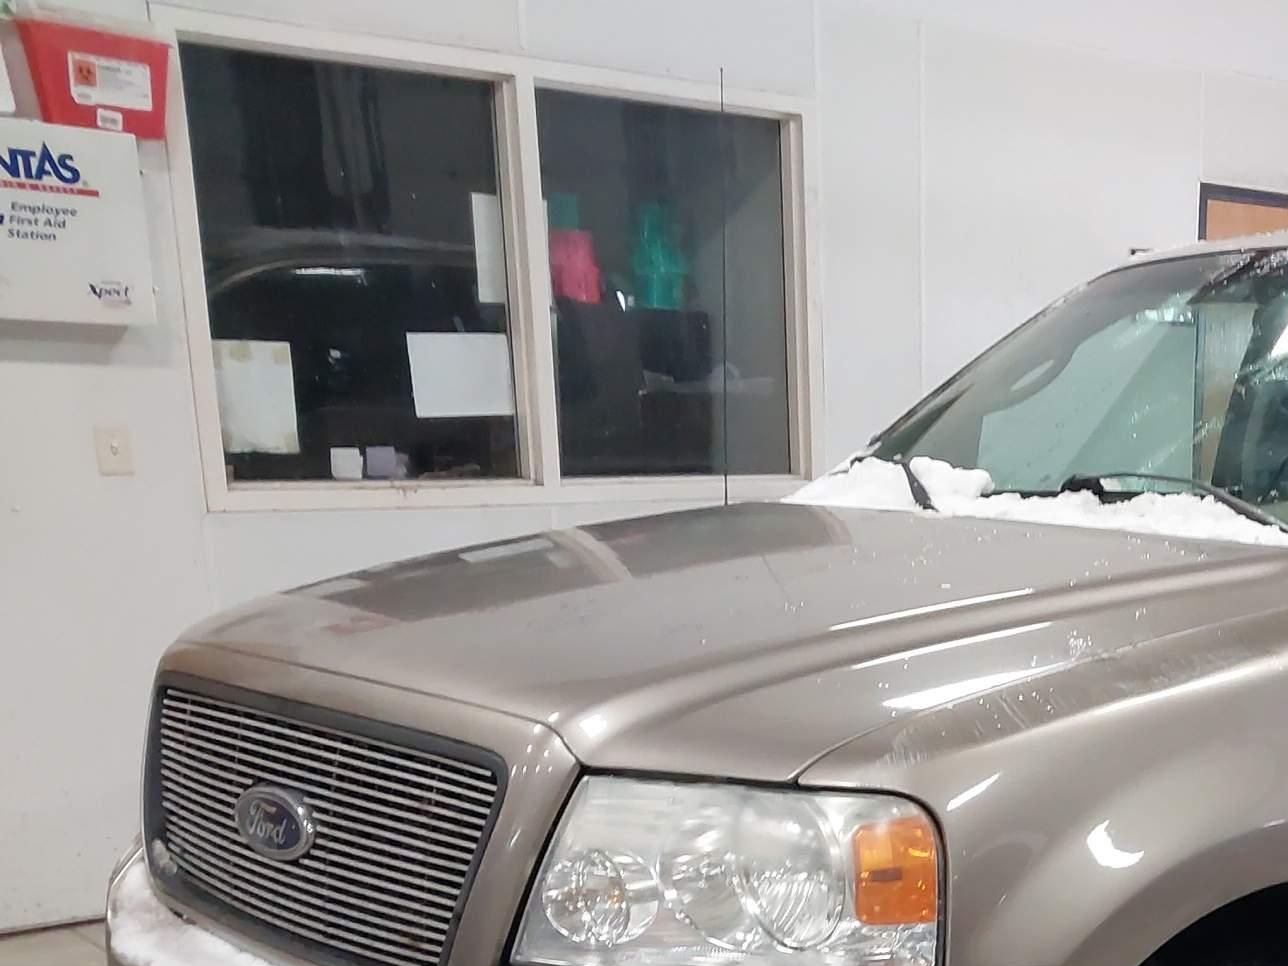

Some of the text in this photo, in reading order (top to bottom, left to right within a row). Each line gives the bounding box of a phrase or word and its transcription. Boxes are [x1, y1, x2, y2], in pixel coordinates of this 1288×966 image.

[11, 201, 78, 217] Employee
[9, 215, 66, 229] First Aid
[8, 228, 57, 241] Station
[247, 799, 287, 845] Ford
